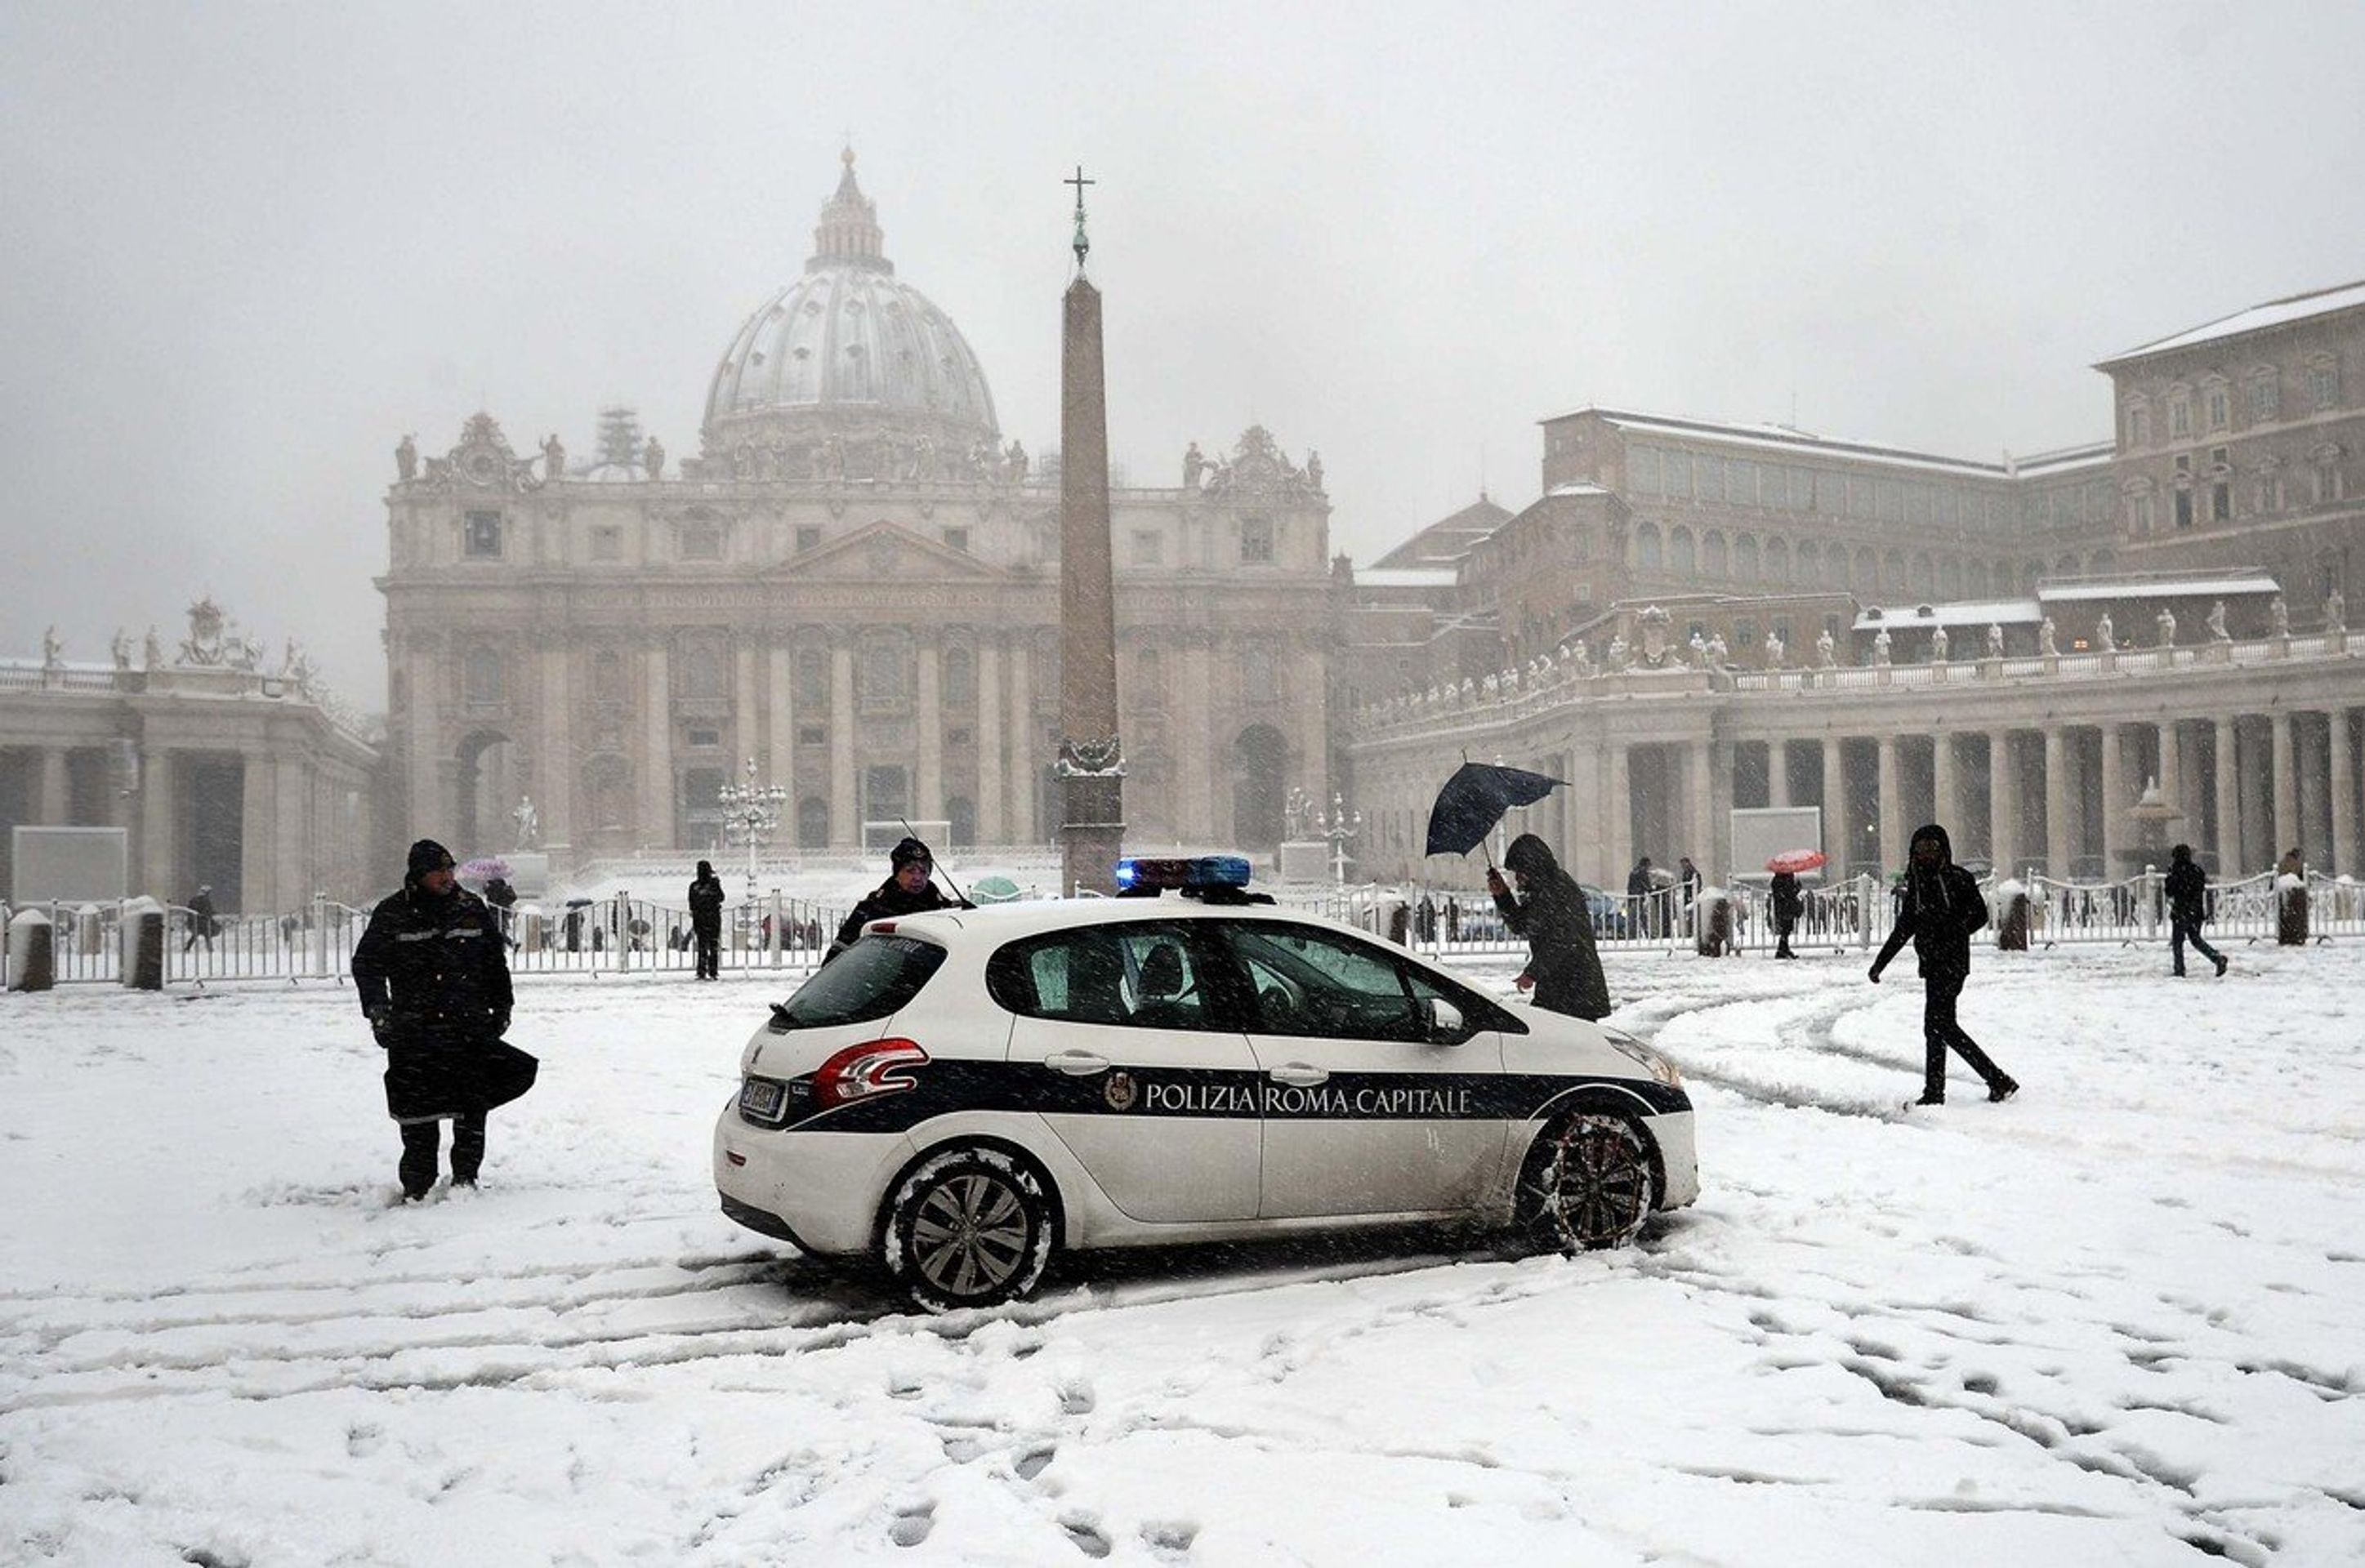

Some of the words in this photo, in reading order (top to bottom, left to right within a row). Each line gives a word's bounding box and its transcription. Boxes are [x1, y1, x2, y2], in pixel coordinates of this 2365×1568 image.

[1146, 1085, 1255, 1111] POLIZIA
[1265, 1087, 1349, 1113] ROMA
[1356, 1088, 1471, 1114] CAPITALE
